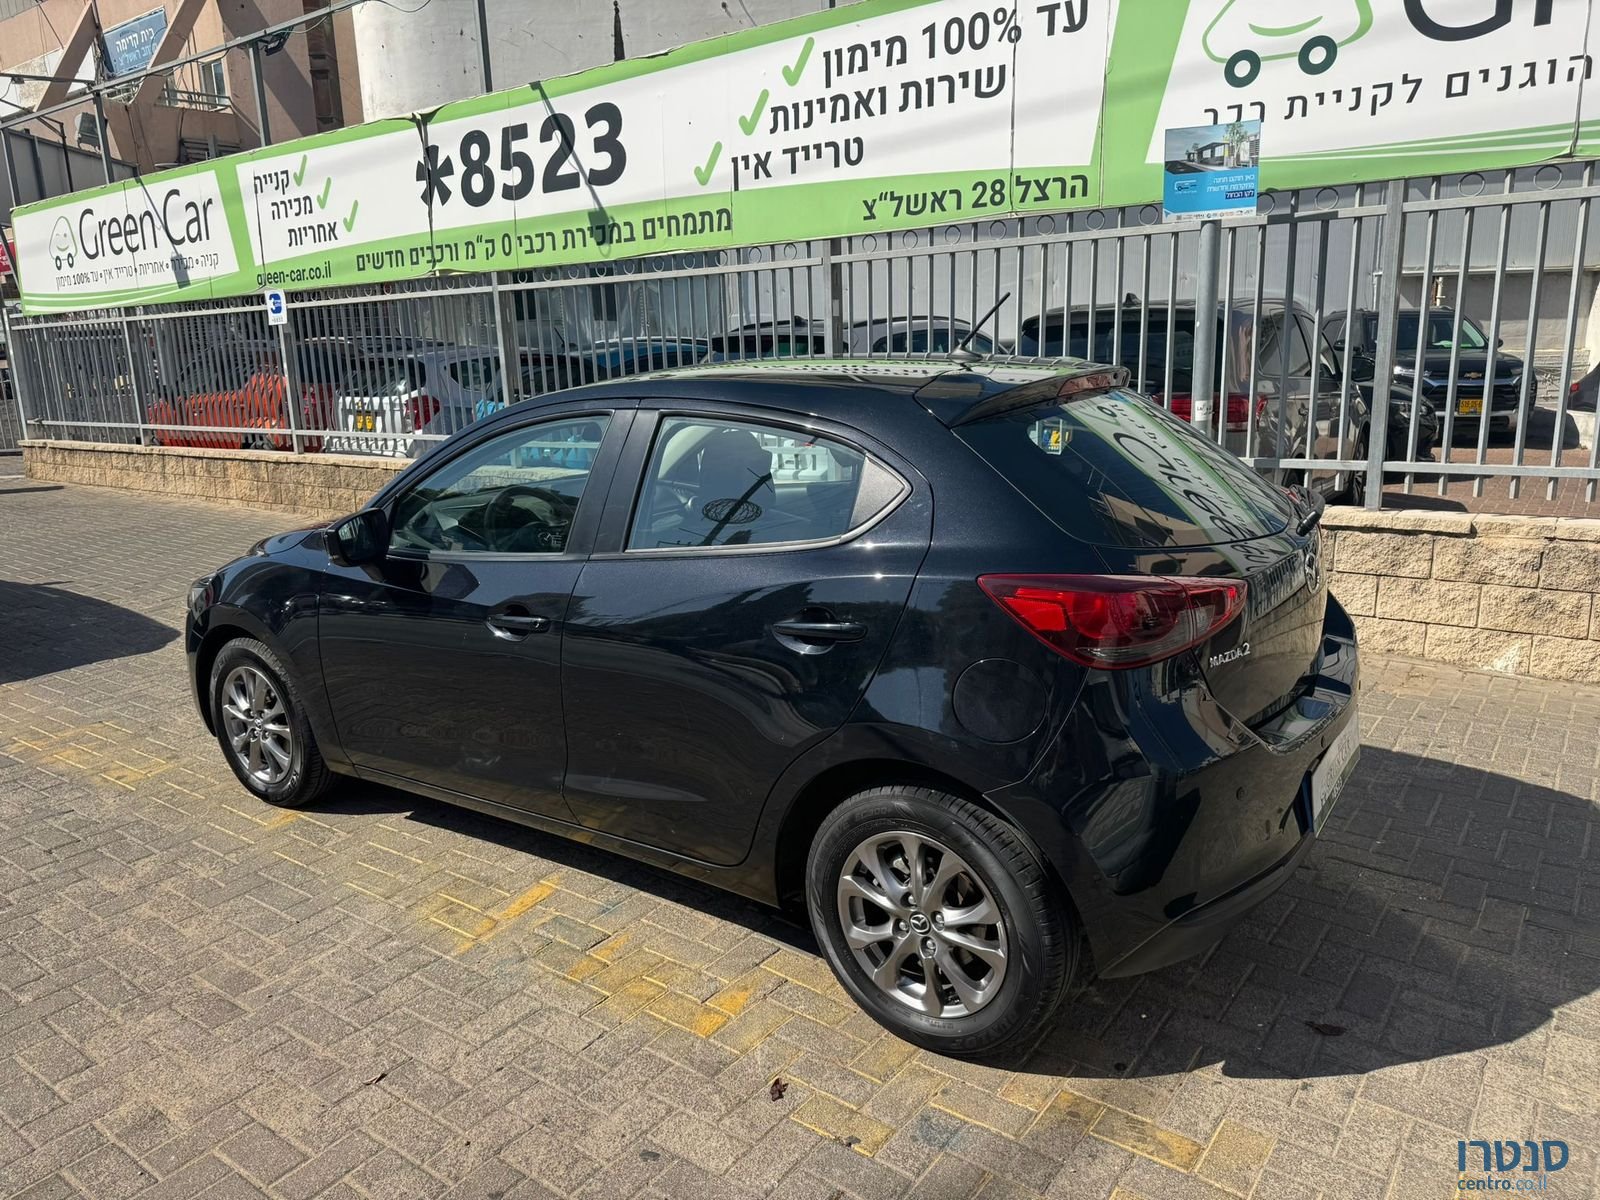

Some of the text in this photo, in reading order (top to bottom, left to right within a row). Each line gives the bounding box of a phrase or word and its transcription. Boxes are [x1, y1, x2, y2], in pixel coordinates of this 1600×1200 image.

[823, 0, 1089, 88] עד 100% מימון
[1446, 54, 1593, 99] הוגנים
[770, 64, 1007, 135] שירות ואמינות
[1284, 73, 1424, 120] לקניית
[731, 136, 864, 191] טרייד אין
[254, 169, 290, 195] קנייה
[971, 178, 1006, 208] 28
[1015, 172, 1088, 204] הרצל
[271, 196, 313, 220] מכירה
[288, 222, 338, 248] אחריות
[563, 220, 636, 251] במכירת
[642, 207, 732, 240] מתמחים
[410, 242, 459, 266] ורכבים
[517, 232, 556, 254] רכבי
[200, 252, 219, 272] קניה
[256, 261, 332, 286] green-car.co.il
[356, 250, 404, 272] חדשים
[72, 272, 90, 286] 100%
